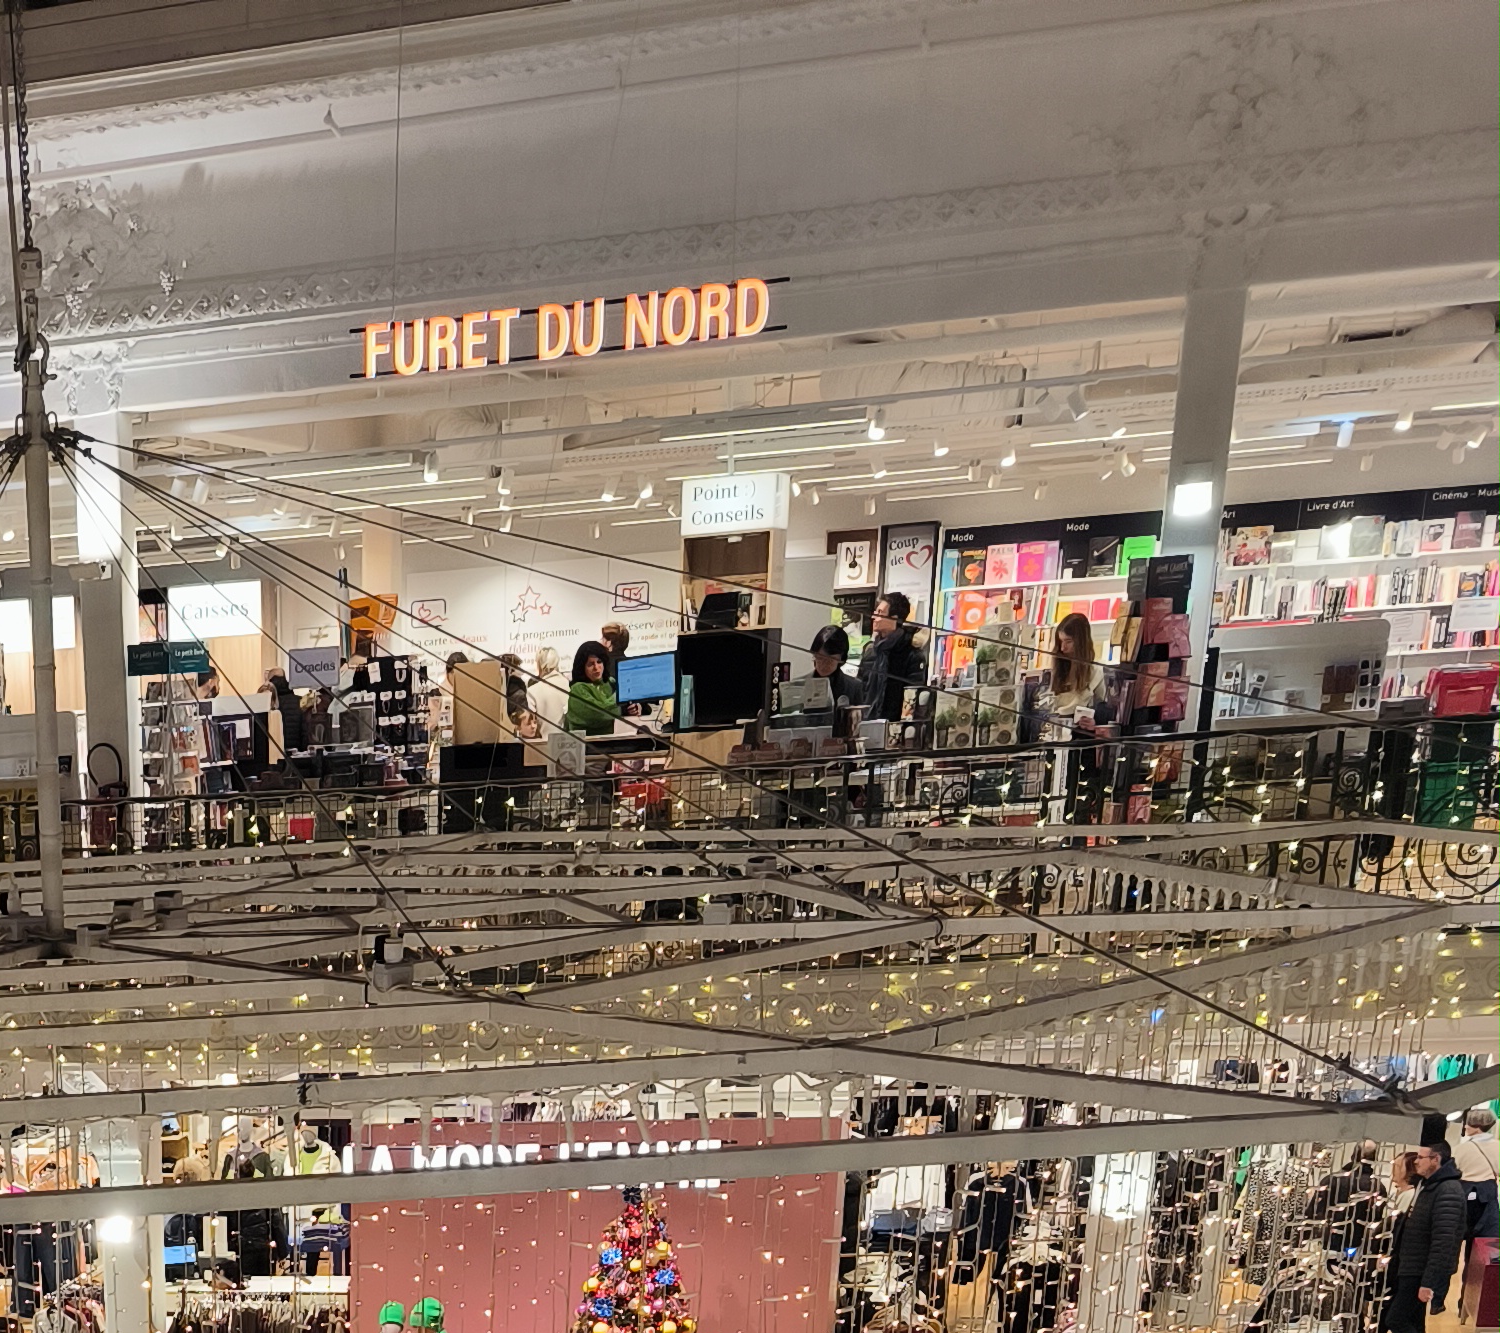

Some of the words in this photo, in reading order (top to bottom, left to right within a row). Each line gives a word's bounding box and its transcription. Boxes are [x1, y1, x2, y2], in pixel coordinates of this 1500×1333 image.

[363, 307, 520, 379] FURET
[537, 298, 606, 361] DU
[625, 277, 770, 351] NORD
[692, 483, 739, 502] Point
[1432, 491, 1469, 501] Cinéma
[1306, 503, 1330, 512] Livre
[692, 504, 764, 526] Conseils
[1066, 522, 1090, 532] Mode
[888, 536, 919, 551] Coup
[951, 533, 975, 543] Mode
[890, 555, 904, 567] de
[181, 602, 249, 621] Caisses
[509, 631, 521, 641] Le
[522, 627, 580, 642] programme
[424, 637, 448, 647] carte
